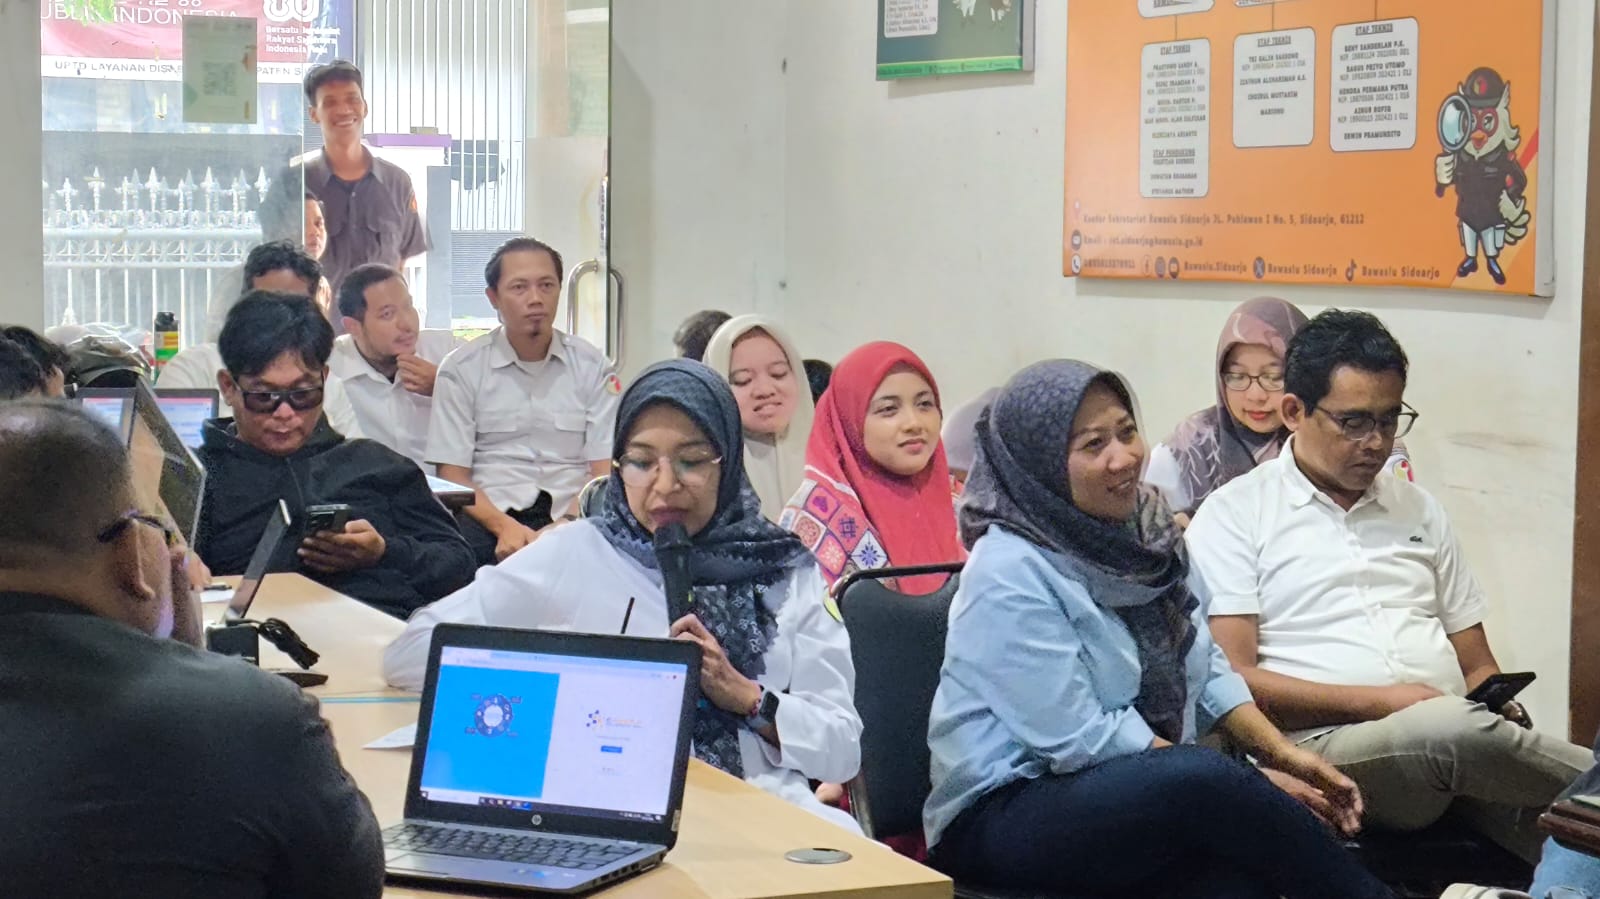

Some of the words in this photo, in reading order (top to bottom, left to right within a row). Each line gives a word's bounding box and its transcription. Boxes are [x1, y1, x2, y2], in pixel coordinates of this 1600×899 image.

[266, 26, 298, 34] Bersatu
[266, 35, 295, 44] Rakyat
[266, 44, 307, 53] Indonesia
[55, 61, 87, 71] UPTD
[91, 63, 145, 73] LAYANAN
[1180, 214, 1210, 226] Sidoarjo
[1268, 263, 1300, 274] Bawaslu
[1303, 264, 1338, 277] Sidoarjo
[1361, 266, 1398, 277] Bawaslu
[1401, 266, 1441, 280] Sidoarjo
